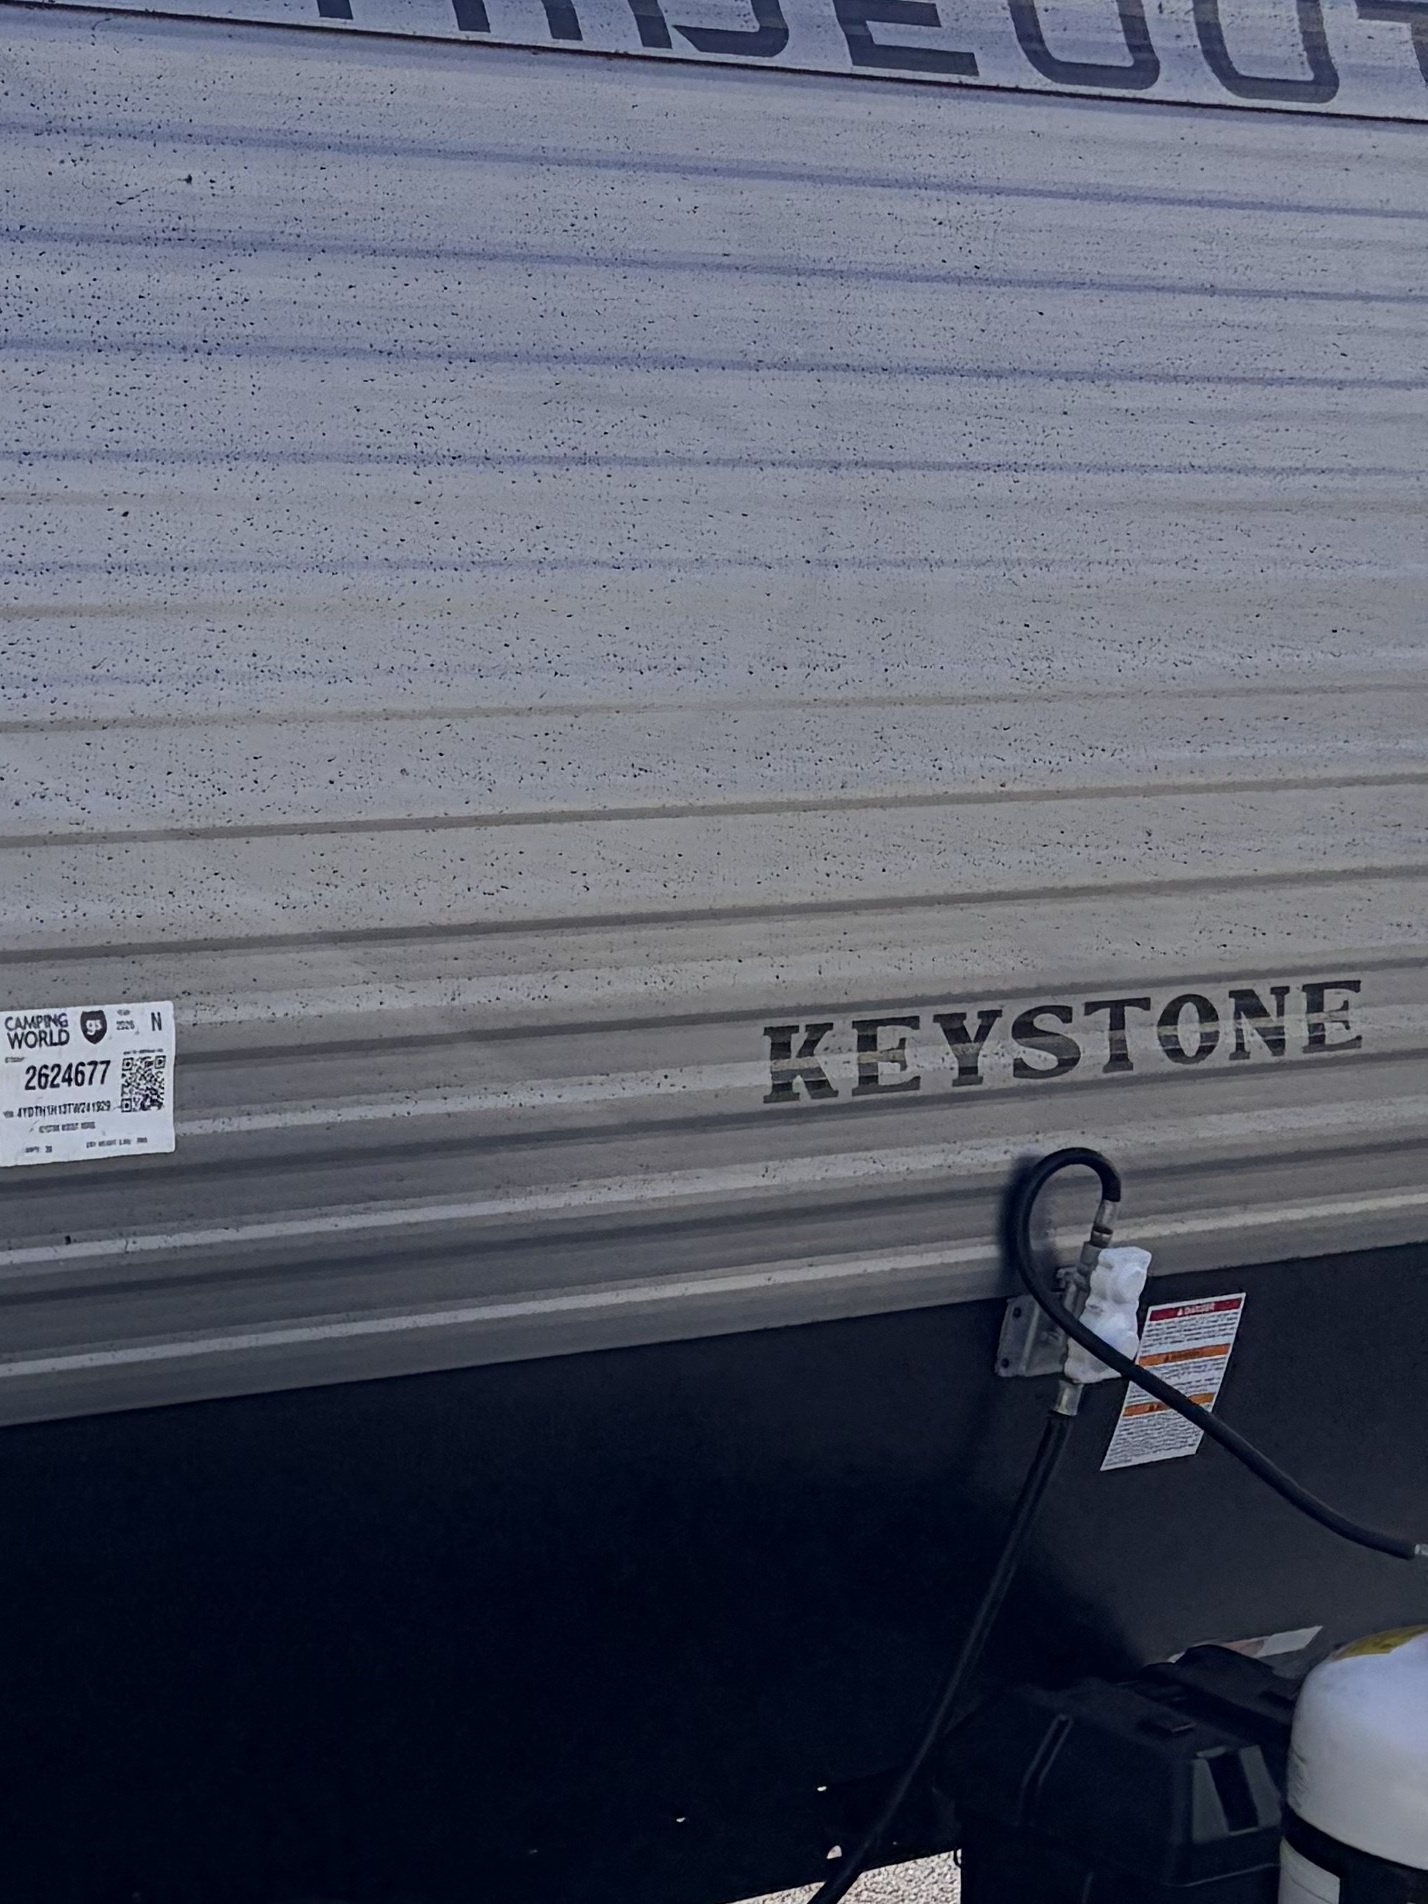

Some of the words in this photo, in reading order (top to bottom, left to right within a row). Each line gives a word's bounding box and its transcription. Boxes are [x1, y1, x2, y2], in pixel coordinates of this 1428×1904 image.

[4, 1013, 68, 1032] CAMPING
[151, 1012, 162, 1031] N
[7, 1029, 70, 1049] WORLD
[762, 979, 1362, 1104] KEYSTONE
[24, 1060, 111, 1090] 2624677
